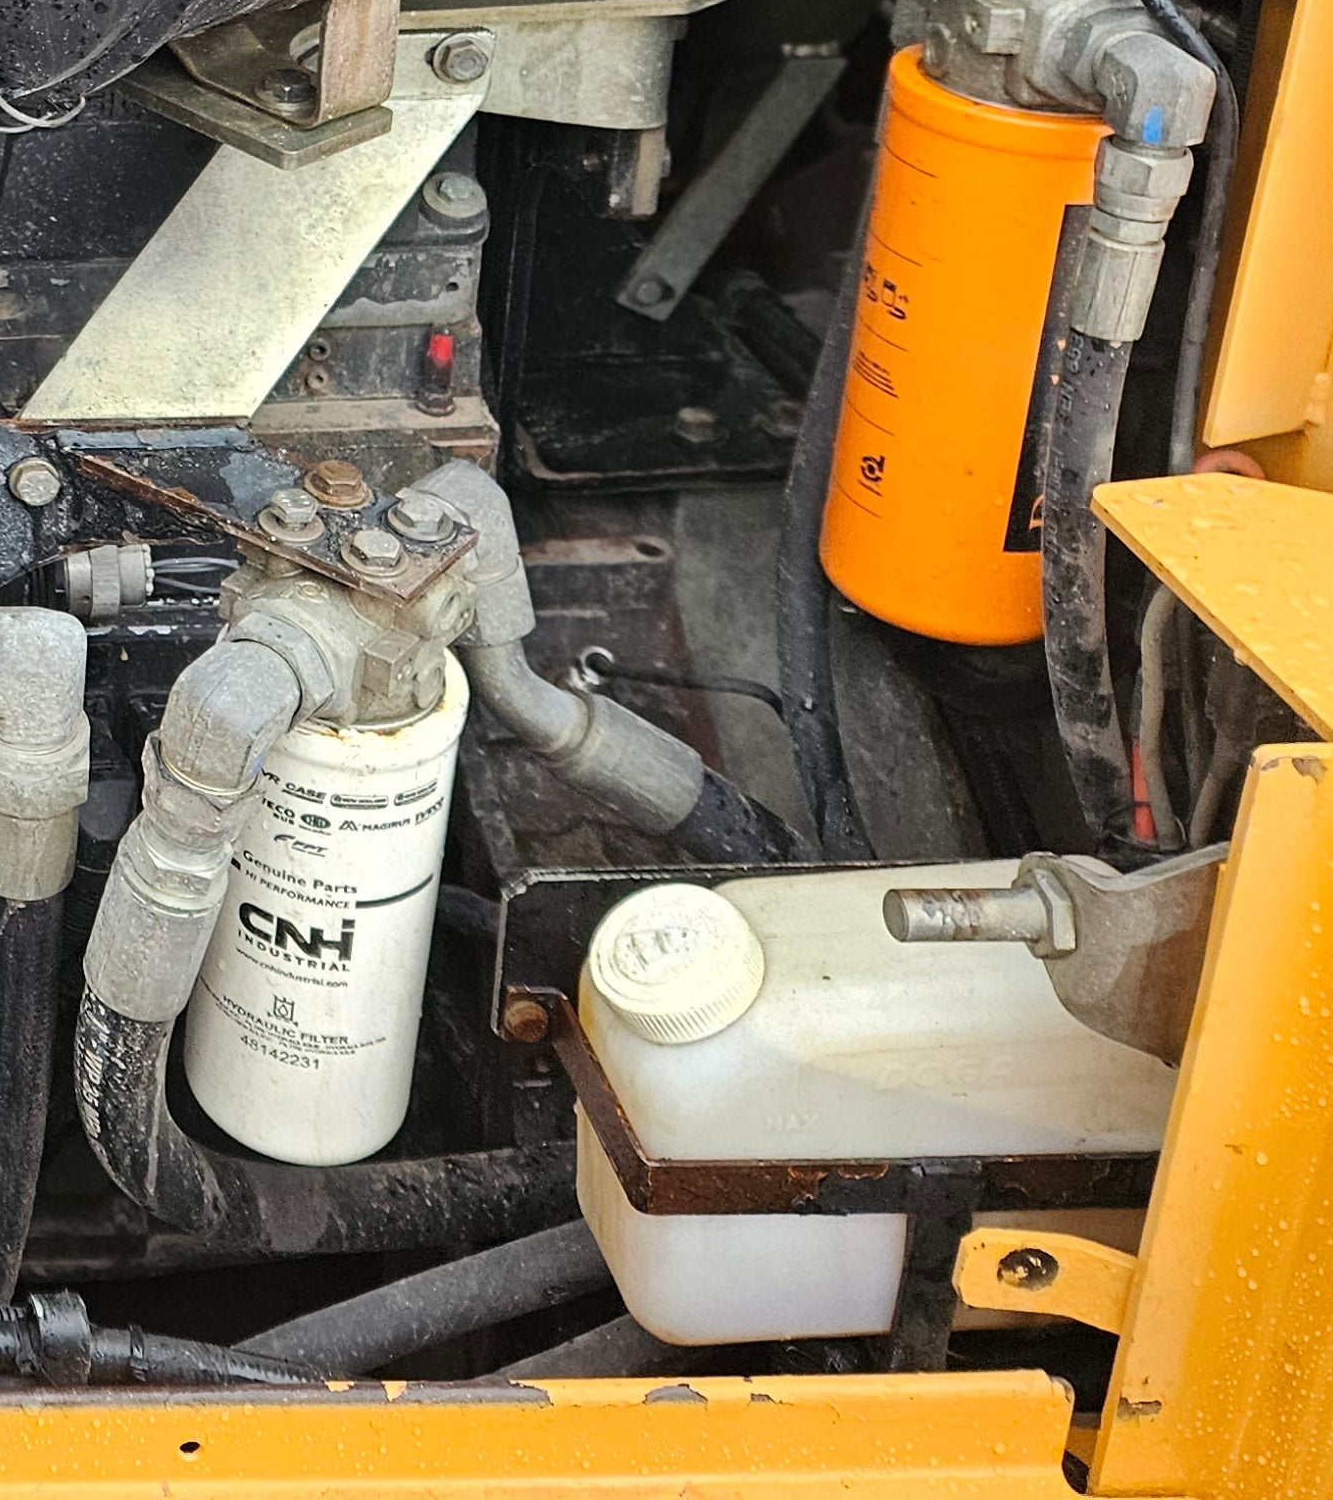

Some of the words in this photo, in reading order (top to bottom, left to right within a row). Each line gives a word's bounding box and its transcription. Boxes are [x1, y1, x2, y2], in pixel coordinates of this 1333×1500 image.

[284, 782, 327, 800] CASE
[243, 850, 306, 888] Genuine
[313, 879, 358, 895] Parts
[245, 869, 257, 881] HI
[260, 877, 350, 909] PERFORMANCE
[236, 947, 348, 988] www.cnhindustrial.com
[238, 929, 350, 972] INDUSTRIAL
[223, 995, 297, 1038] HYDRAULIC
[300, 1032, 349, 1044] FILTER
[240, 1035, 321, 1070] 48142231
[766, 1113, 818, 1132] MAX
